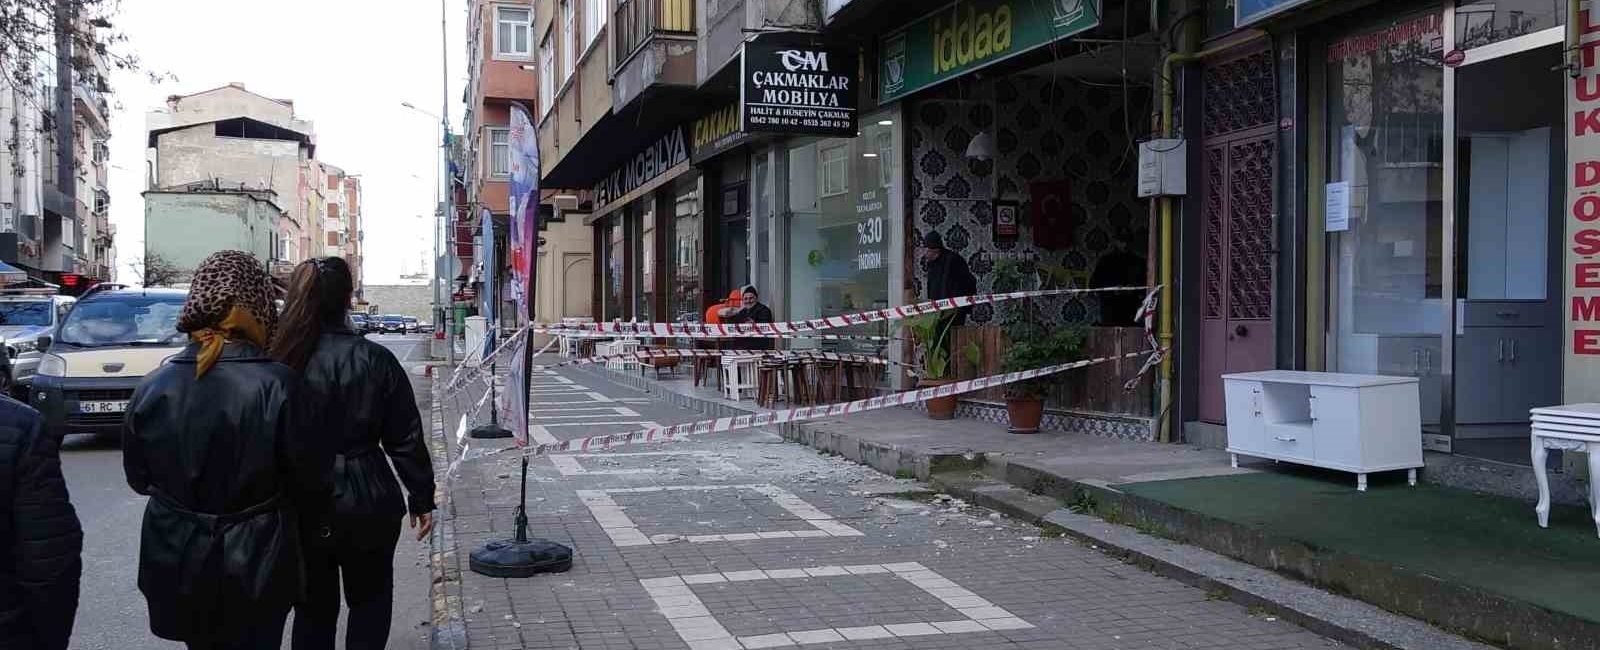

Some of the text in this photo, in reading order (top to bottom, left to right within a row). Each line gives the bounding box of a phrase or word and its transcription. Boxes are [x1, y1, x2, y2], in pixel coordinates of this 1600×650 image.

[932, 3, 1012, 75] iddaa
[752, 70, 849, 91] ÇAKMAKLAR
[763, 88, 839, 107] MOBİLYA
[750, 106, 773, 116] HALİT
[783, 107, 817, 118] HÜSEYİN
[818, 110, 850, 119] ÇAKMAK
[695, 103, 740, 154] ÇAKMA
[624, 124, 688, 193] MOBİLYA
[857, 216, 883, 245] %30
[100, 402, 112, 411] RC
